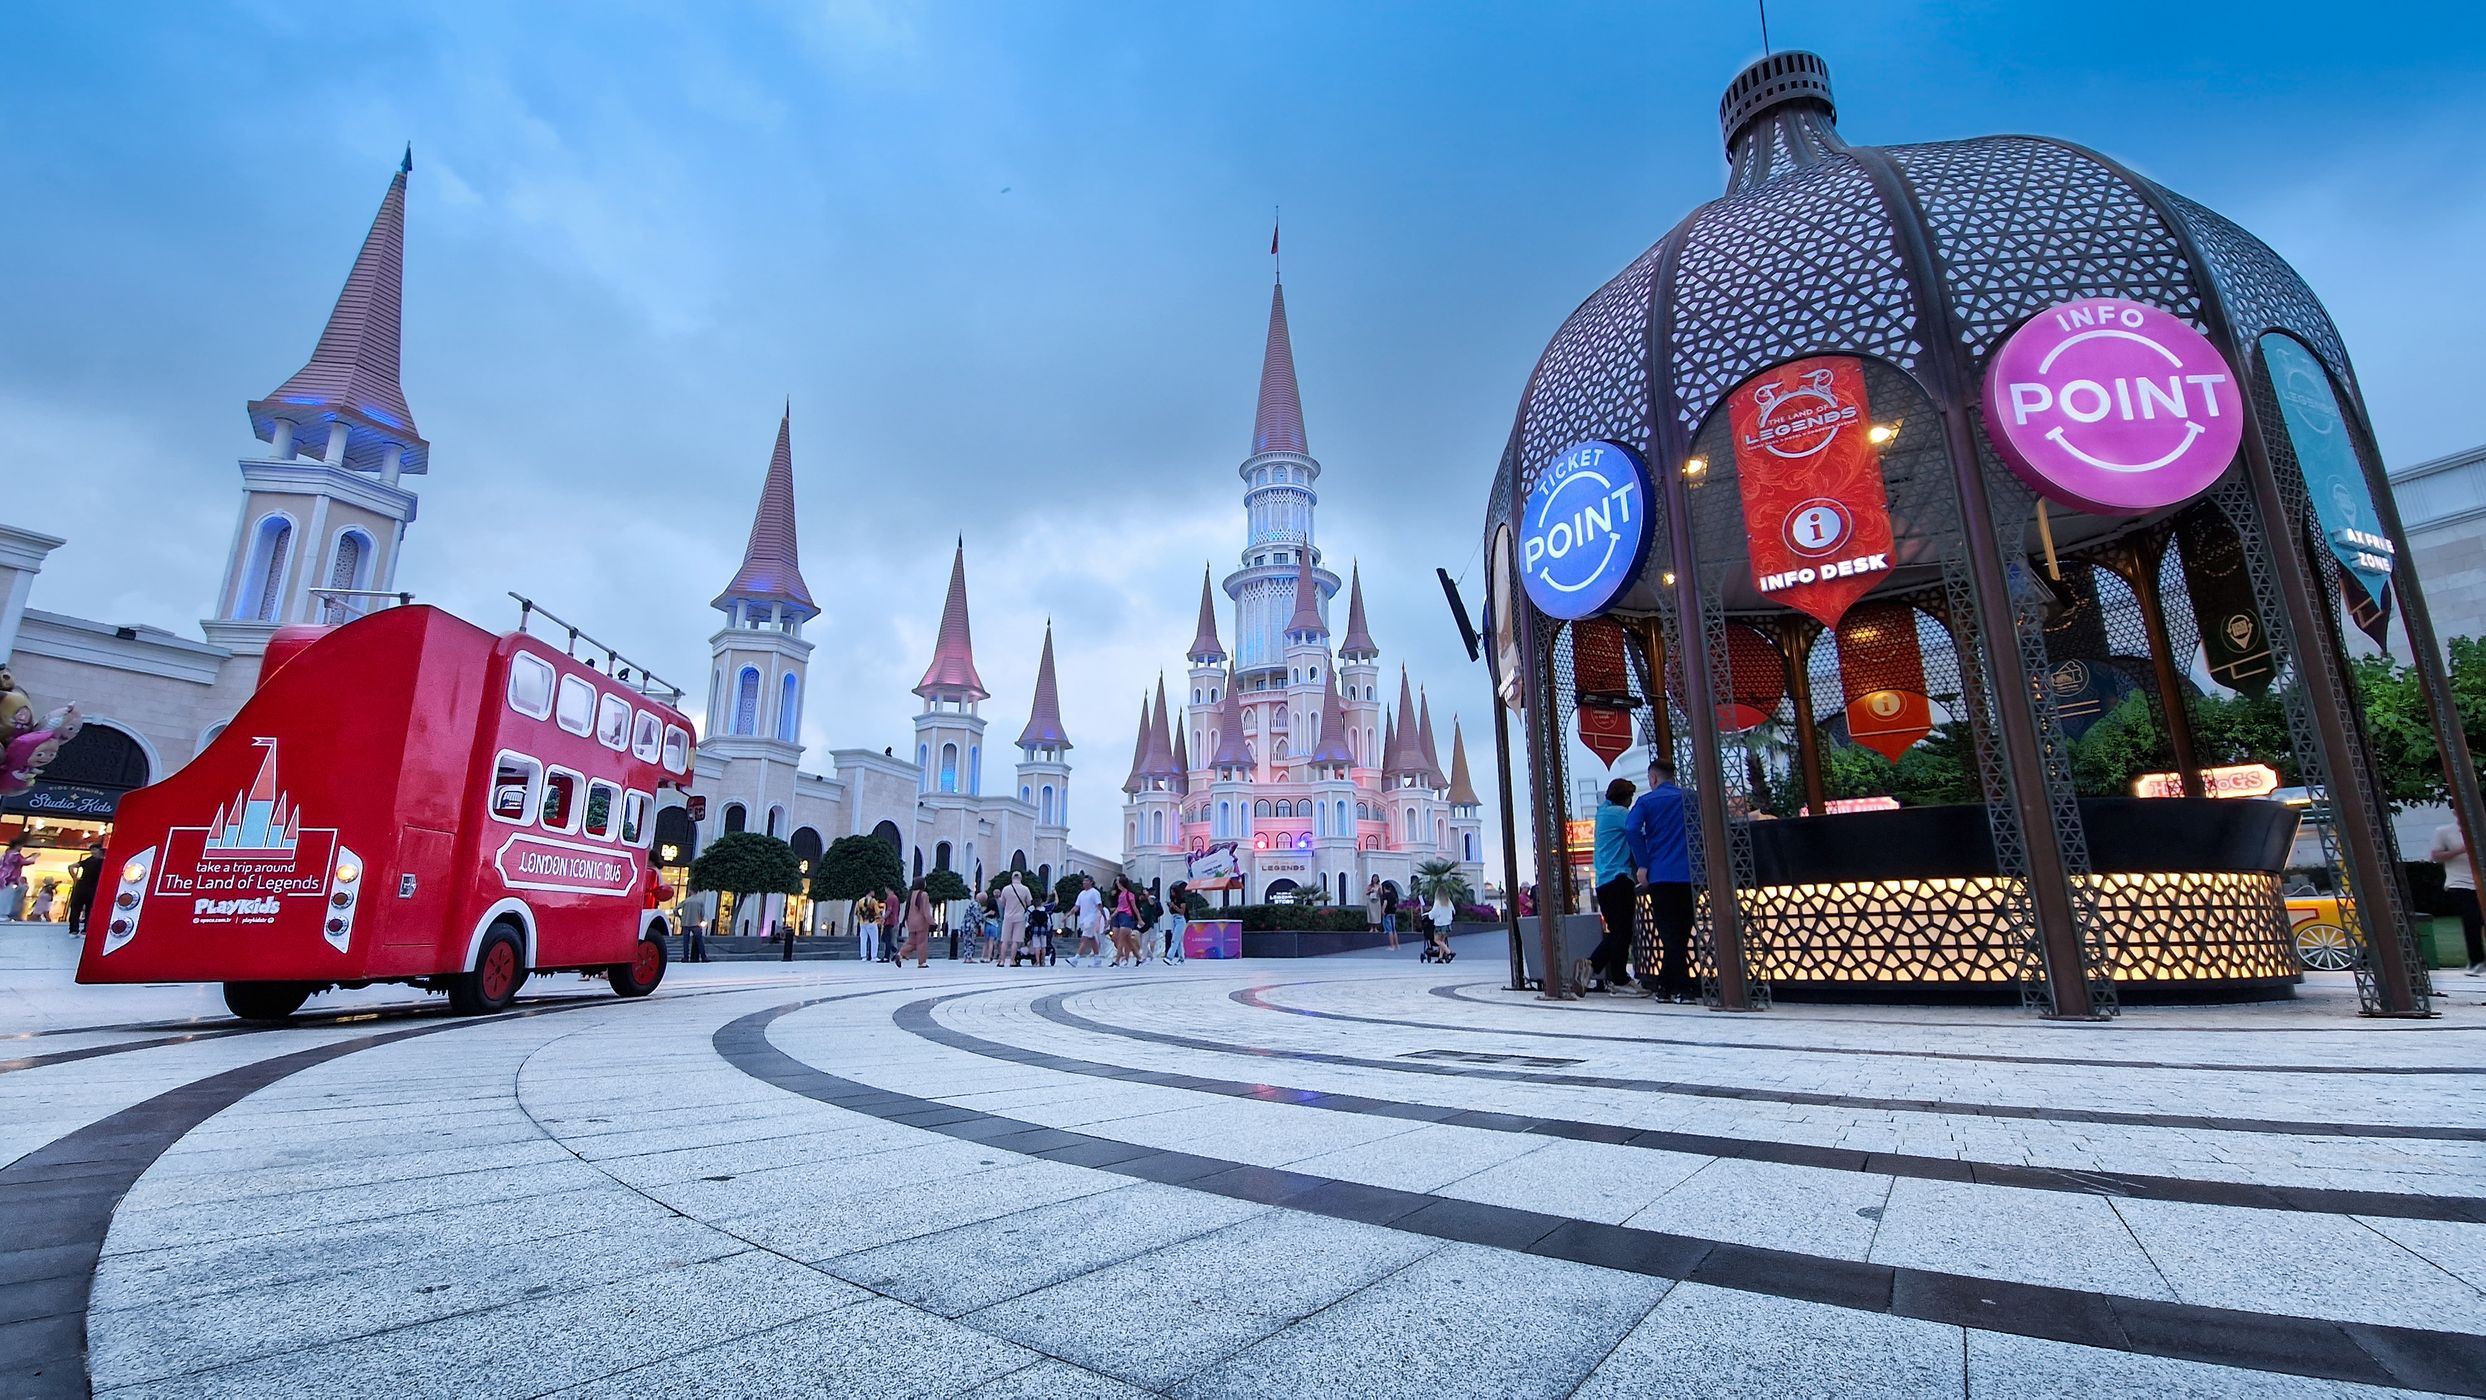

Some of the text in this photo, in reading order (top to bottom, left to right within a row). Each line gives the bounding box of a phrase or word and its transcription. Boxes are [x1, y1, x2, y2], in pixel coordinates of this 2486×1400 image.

[2056, 306, 2144, 332] INFO
[2010, 374, 2226, 425] POINT
[1745, 406, 1857, 445] LEGENDS
[1768, 416, 1785, 425] THE
[1788, 408, 1813, 420] LAND
[1538, 449, 1604, 496] TICKET
[1524, 482, 1635, 574] POINT
[1760, 553, 1888, 592] INFO DESK
[2358, 551, 2391, 573] ZONE
[29, 793, 113, 813] Studio Kids
[196, 862, 296, 875] take a trip around
[518, 851, 622, 882] LONDON ICONIC BUS
[165, 874, 319, 893] The Land of Legends
